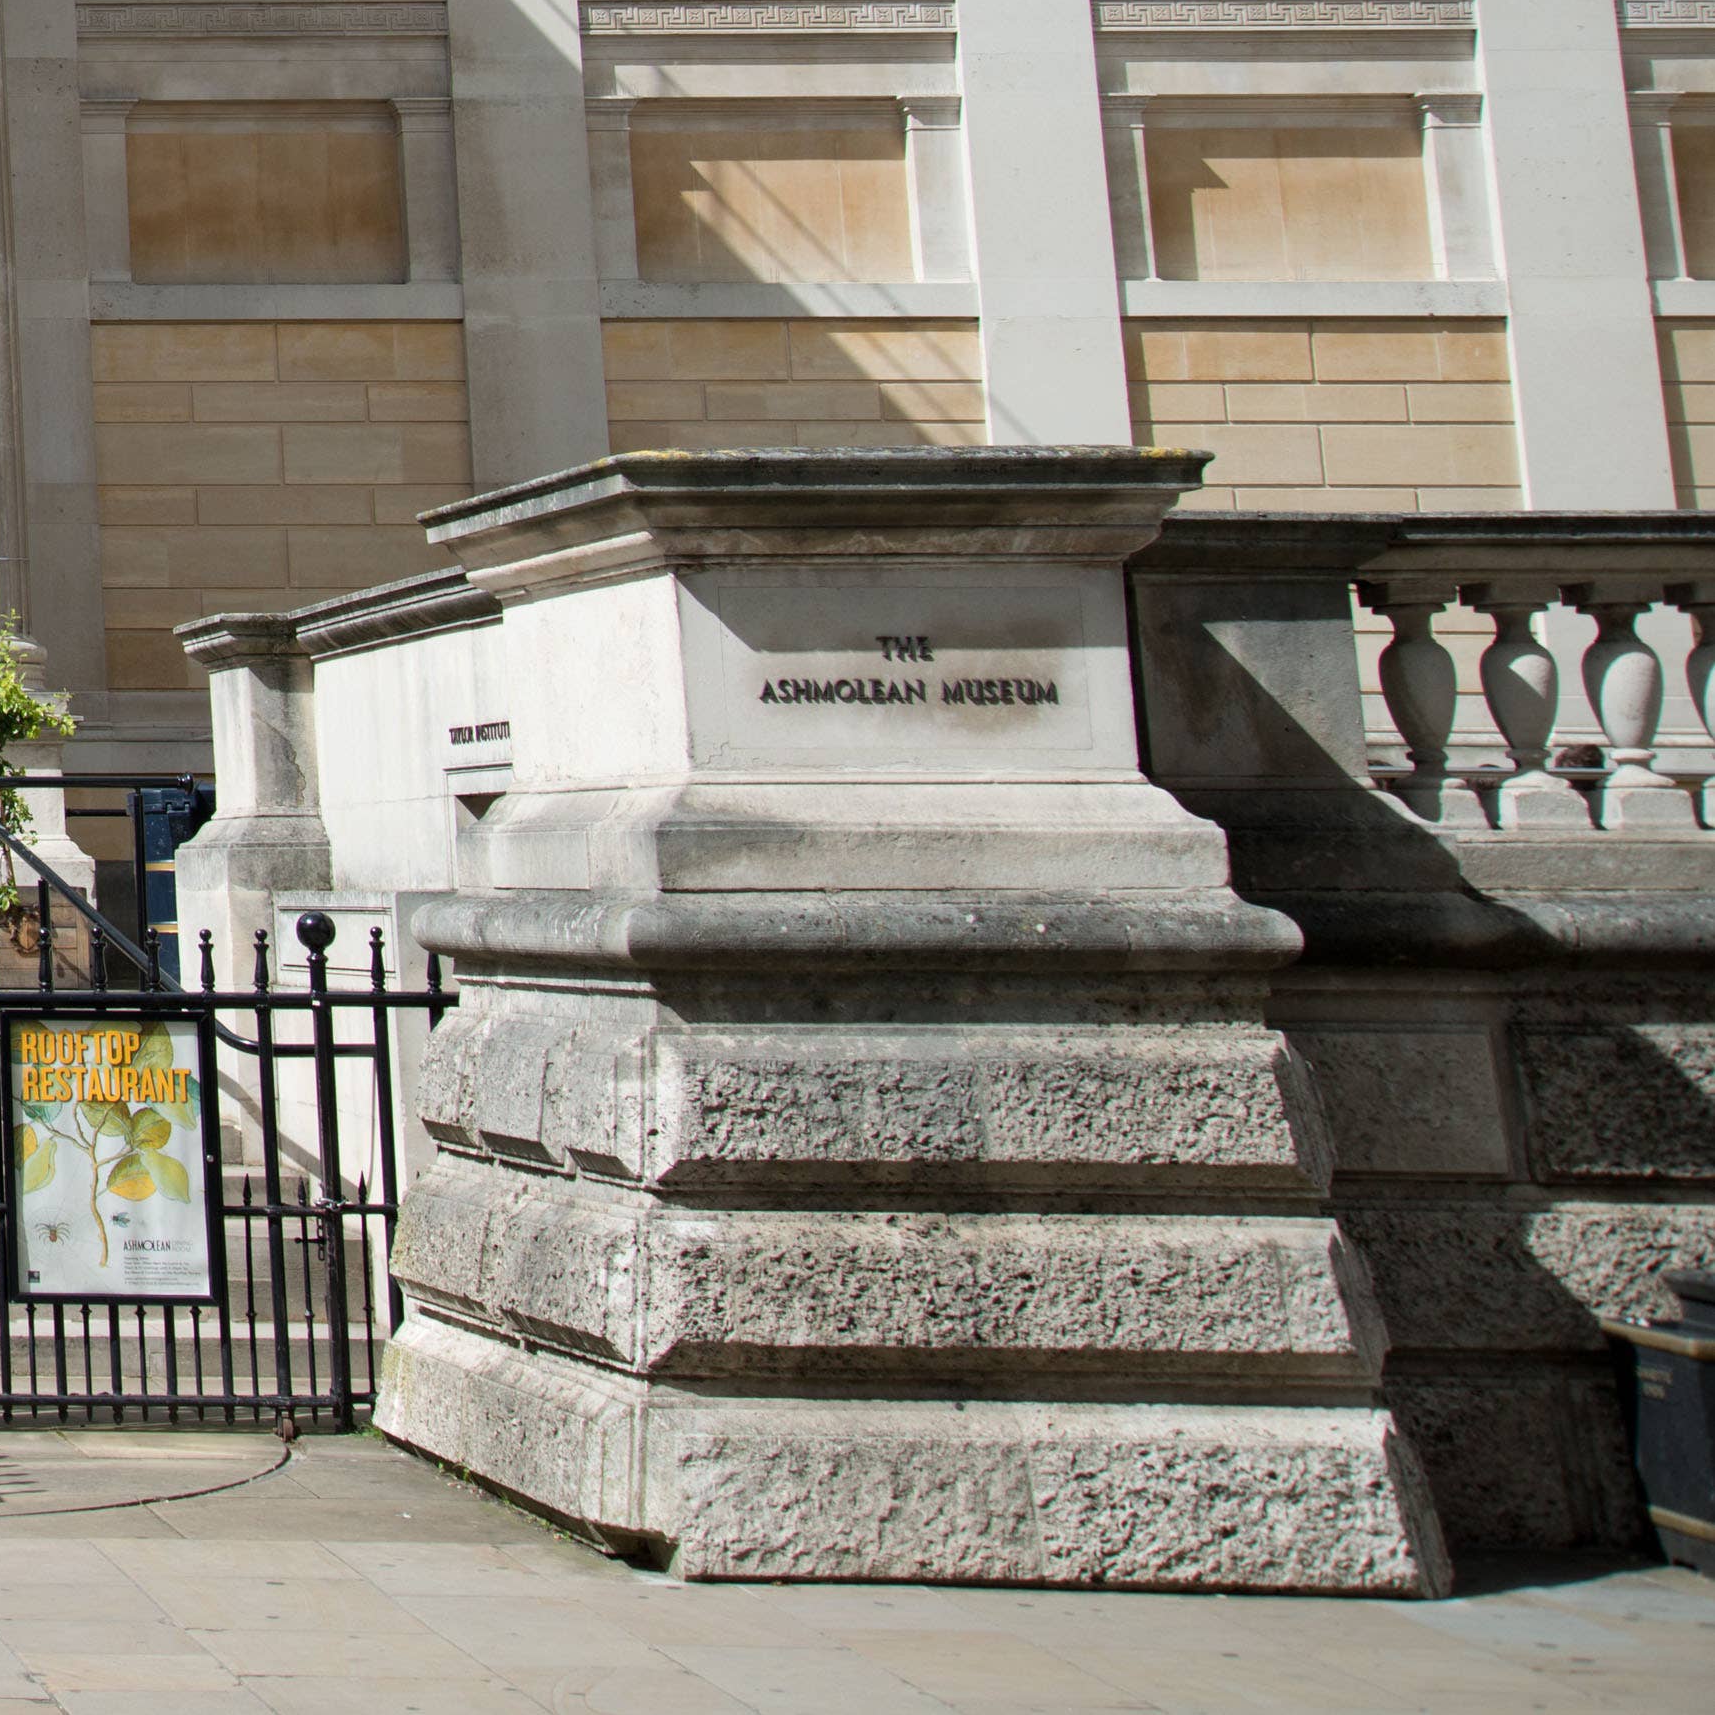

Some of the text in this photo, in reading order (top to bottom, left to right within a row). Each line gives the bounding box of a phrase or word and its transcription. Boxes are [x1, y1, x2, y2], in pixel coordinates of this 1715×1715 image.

[876, 636, 934, 663] THE
[759, 678, 1060, 705] ASHMOLEAN MUSEUM
[22, 1030, 140, 1065] ROOFTOP
[23, 1067, 191, 1103] RESTAURANT
[123, 1240, 171, 1252] ASHMOLEAN
